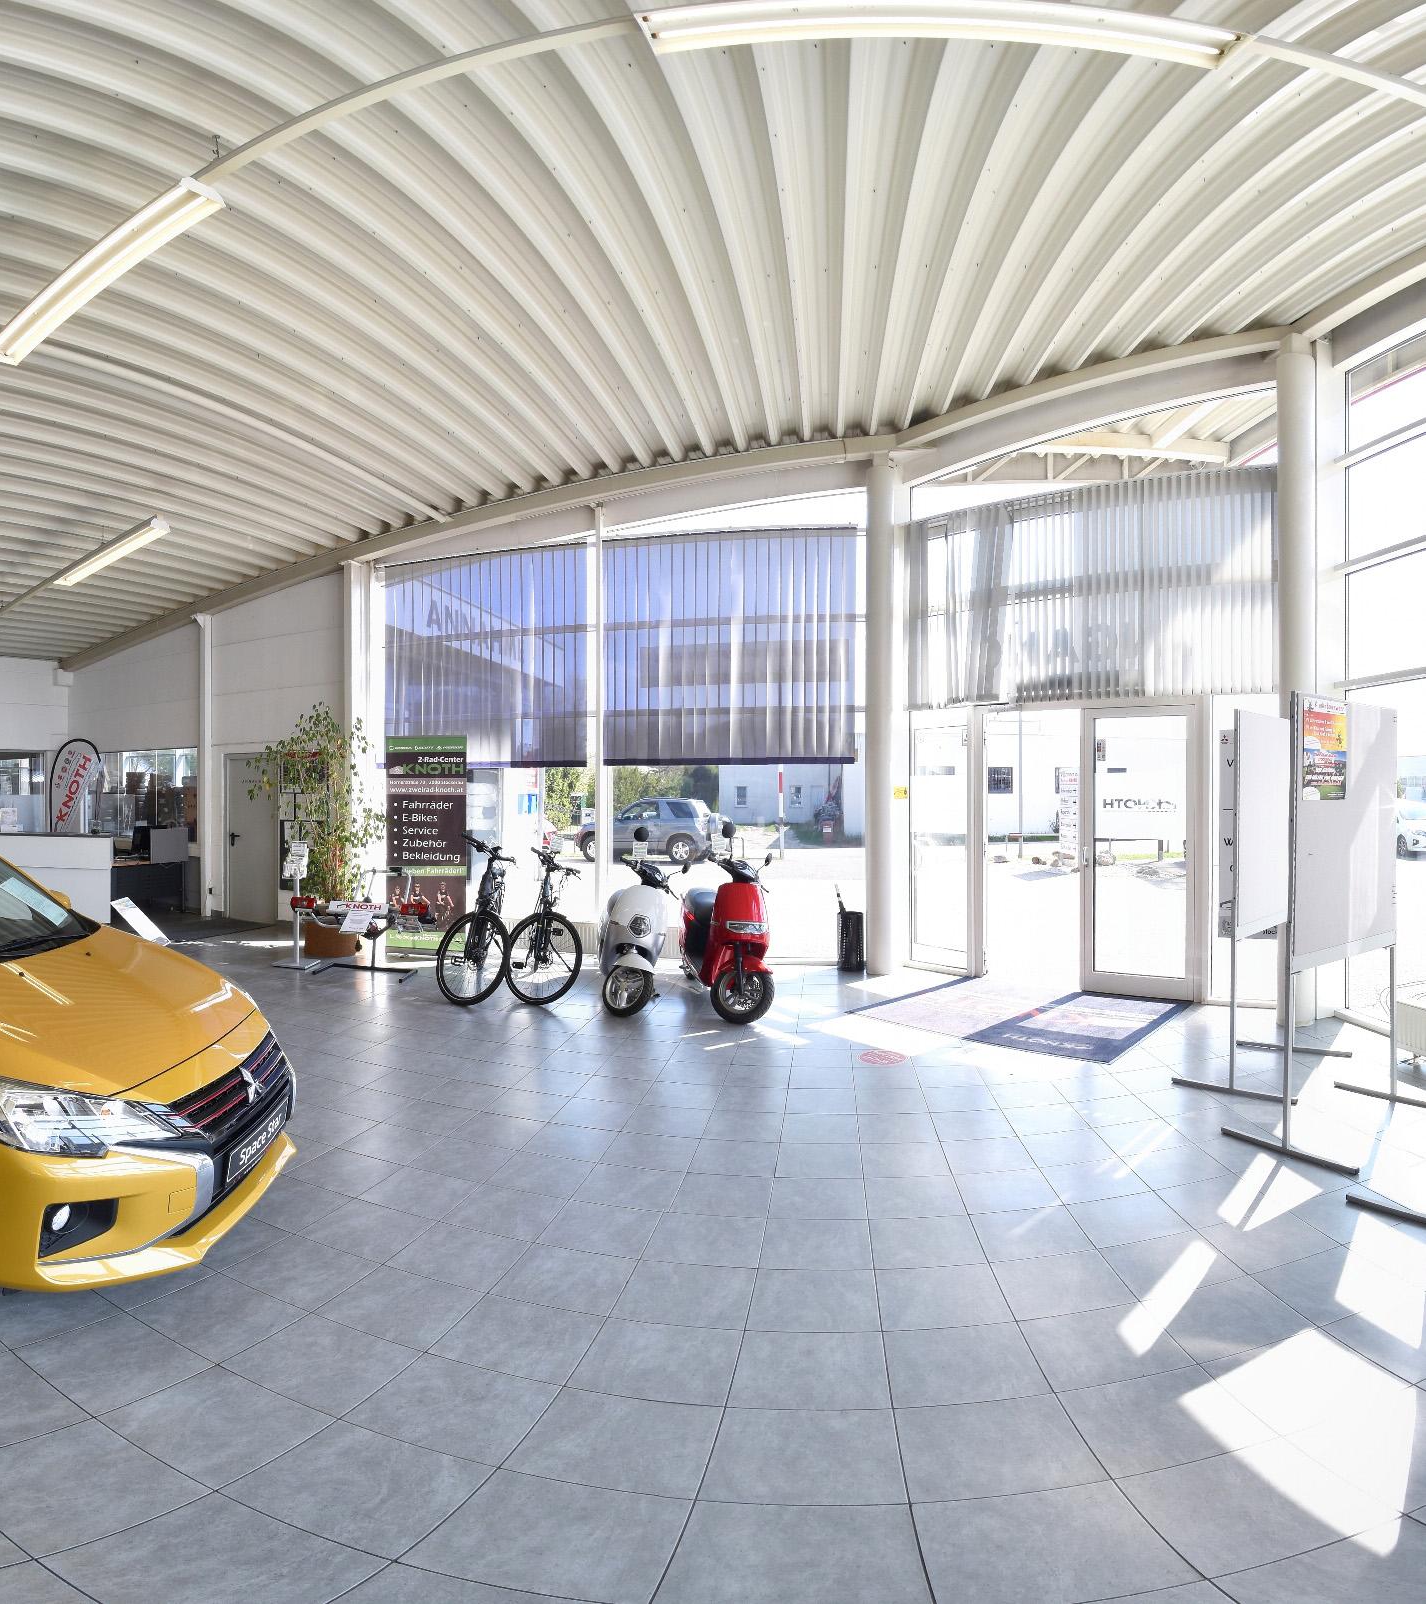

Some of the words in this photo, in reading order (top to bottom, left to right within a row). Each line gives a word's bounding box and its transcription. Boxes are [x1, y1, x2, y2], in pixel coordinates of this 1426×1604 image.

[402, 763, 464, 775] KNOTH
[56, 754, 92, 823] KNOTH
[402, 800, 454, 810] Fahrräder
[402, 813, 438, 822] E-Bikes
[402, 826, 439, 835] Service
[402, 839, 447, 848] Zubehör
[402, 852, 461, 863] Bekleidung
[345, 903, 382, 911] KNOTH
[239, 1129, 267, 1166] Space
[267, 1112, 282, 1139] Star
